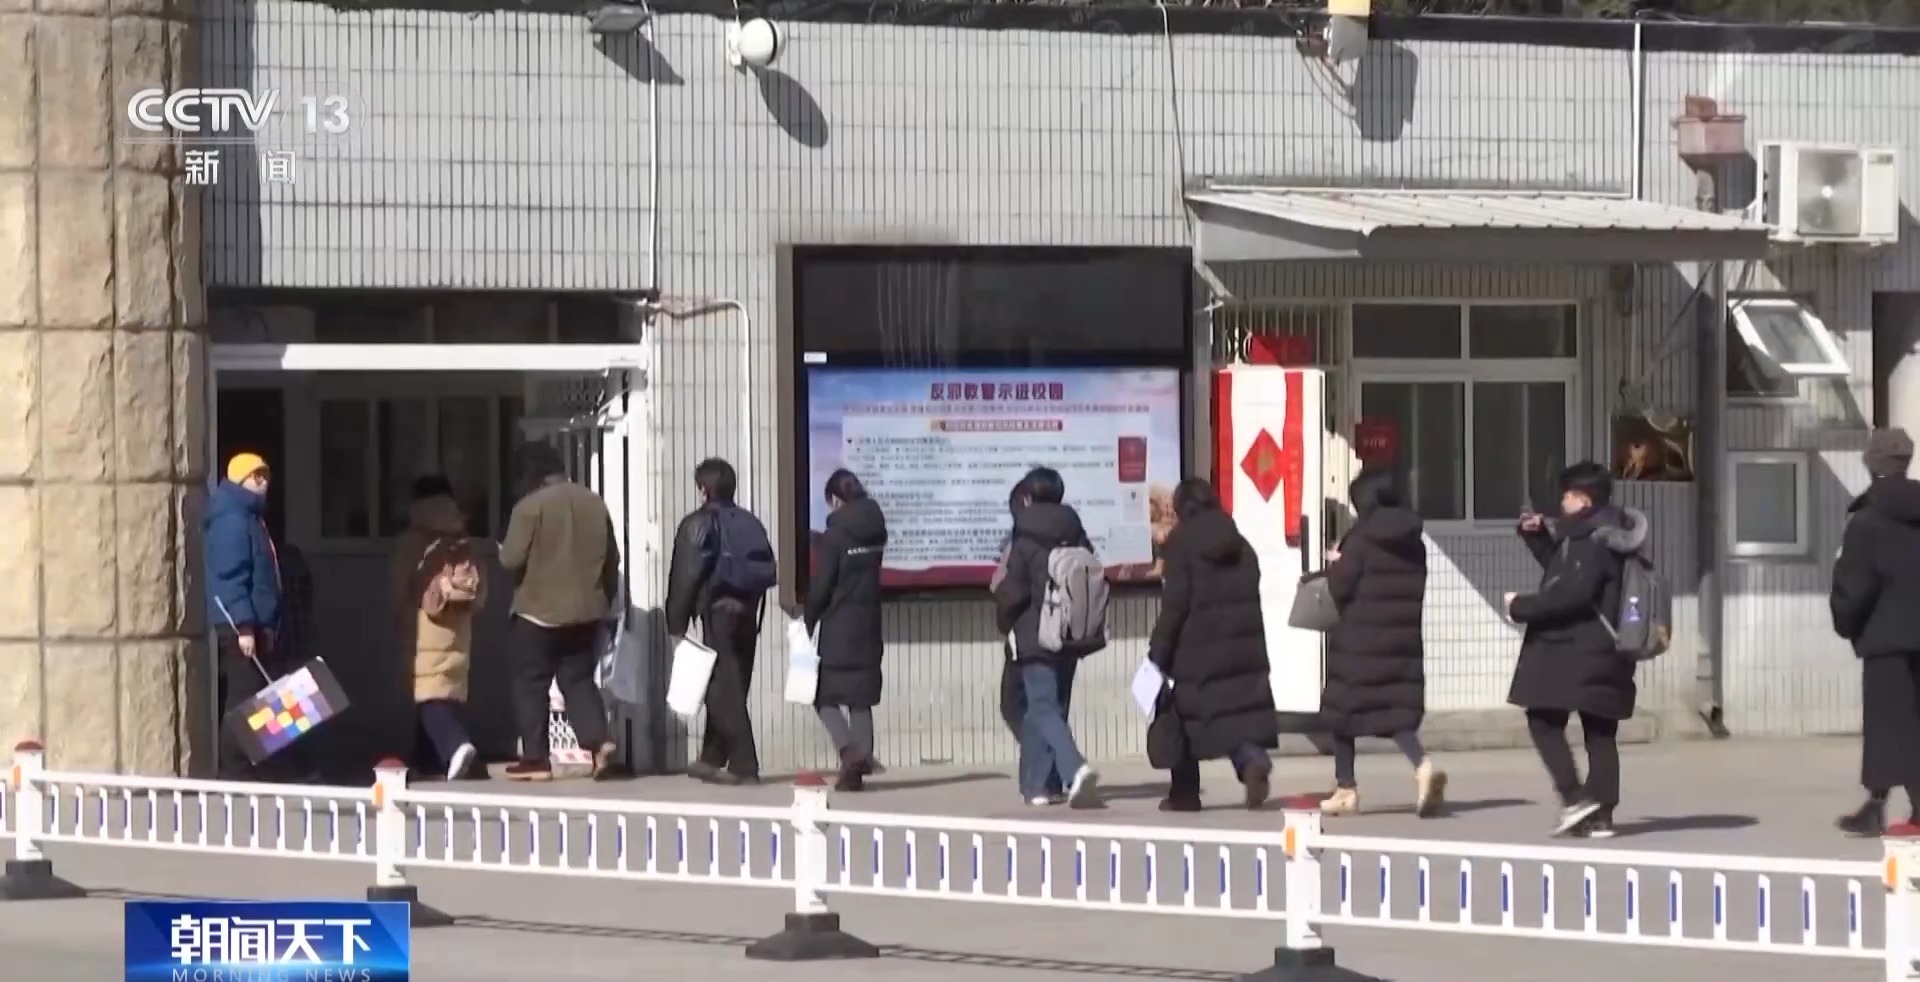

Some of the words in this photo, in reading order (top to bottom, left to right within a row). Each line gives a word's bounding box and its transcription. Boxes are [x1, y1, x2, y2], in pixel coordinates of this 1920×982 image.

[930, 383, 1064, 401] 反邪教警示进校园
